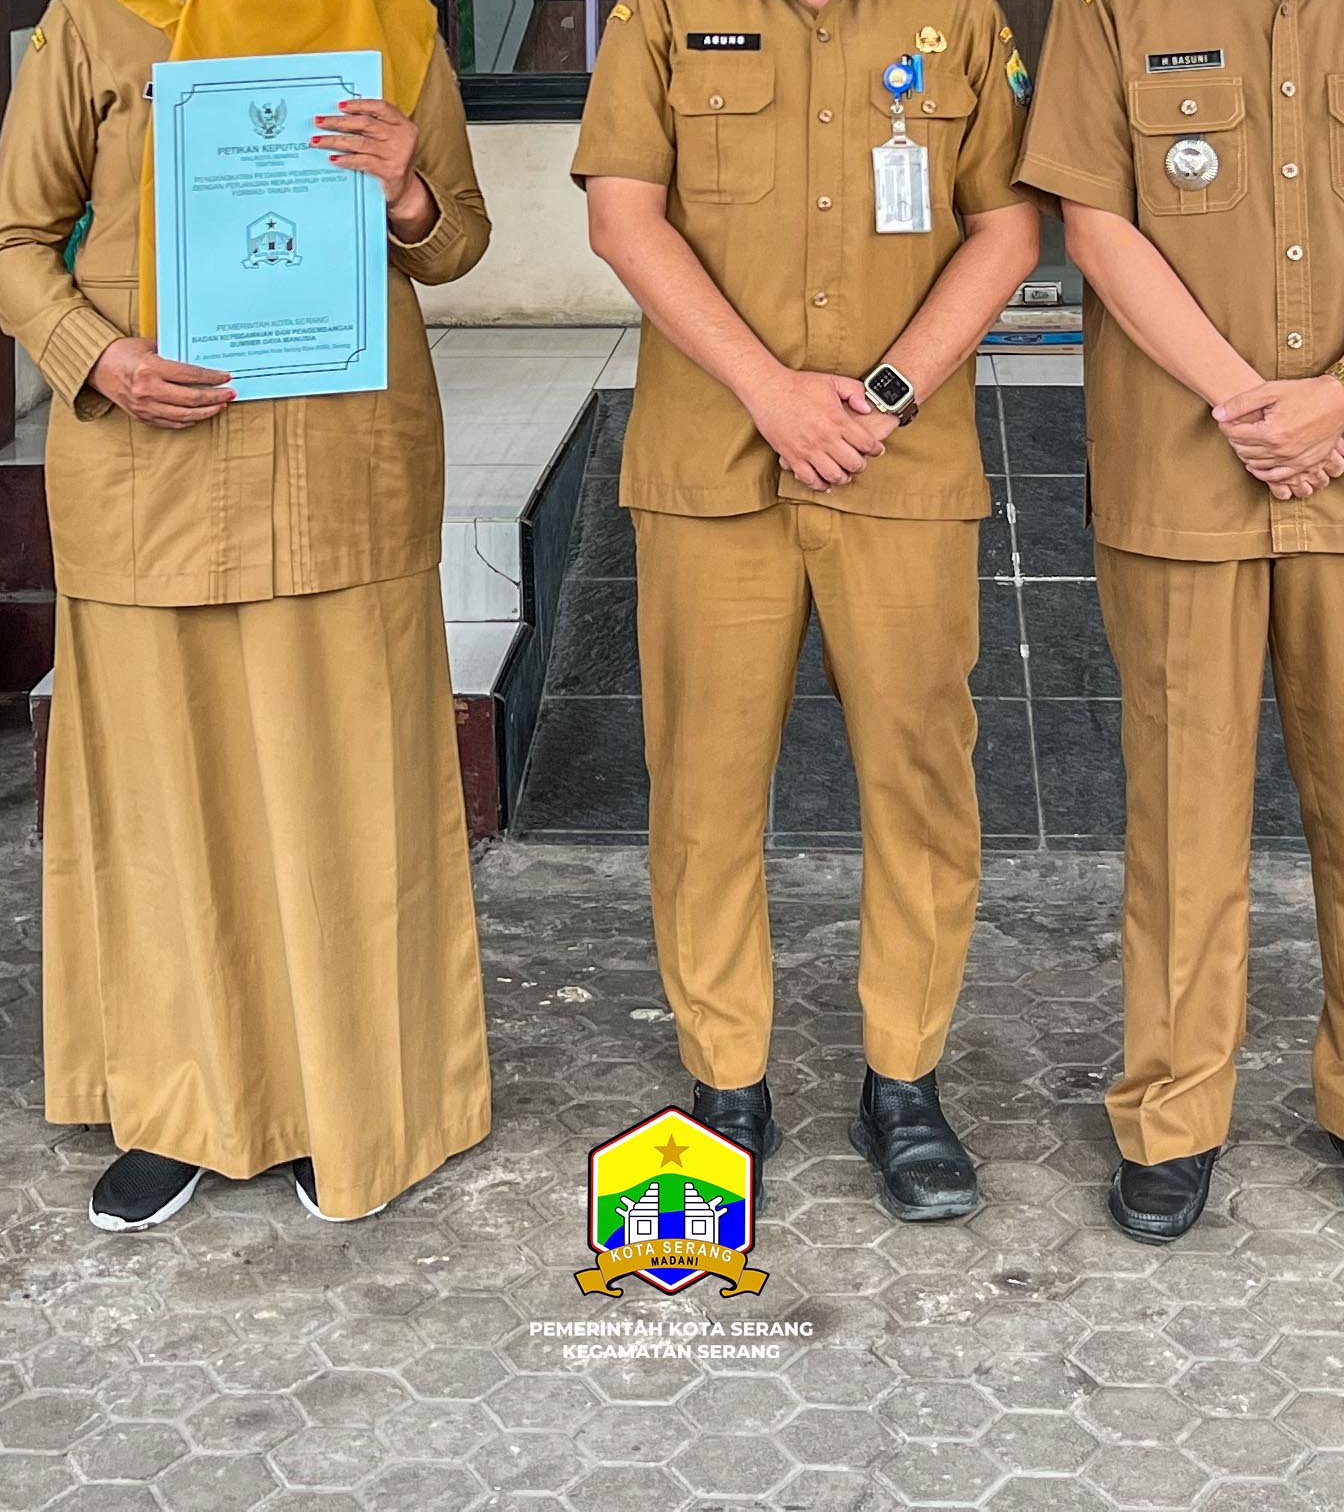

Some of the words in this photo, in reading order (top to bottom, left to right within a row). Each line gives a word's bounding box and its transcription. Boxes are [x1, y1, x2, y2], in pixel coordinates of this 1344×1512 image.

[704, 36, 745, 45] AGUNG
[218, 147, 259, 155] PETIKAN
[216, 322, 270, 331] PEMERINTAH
